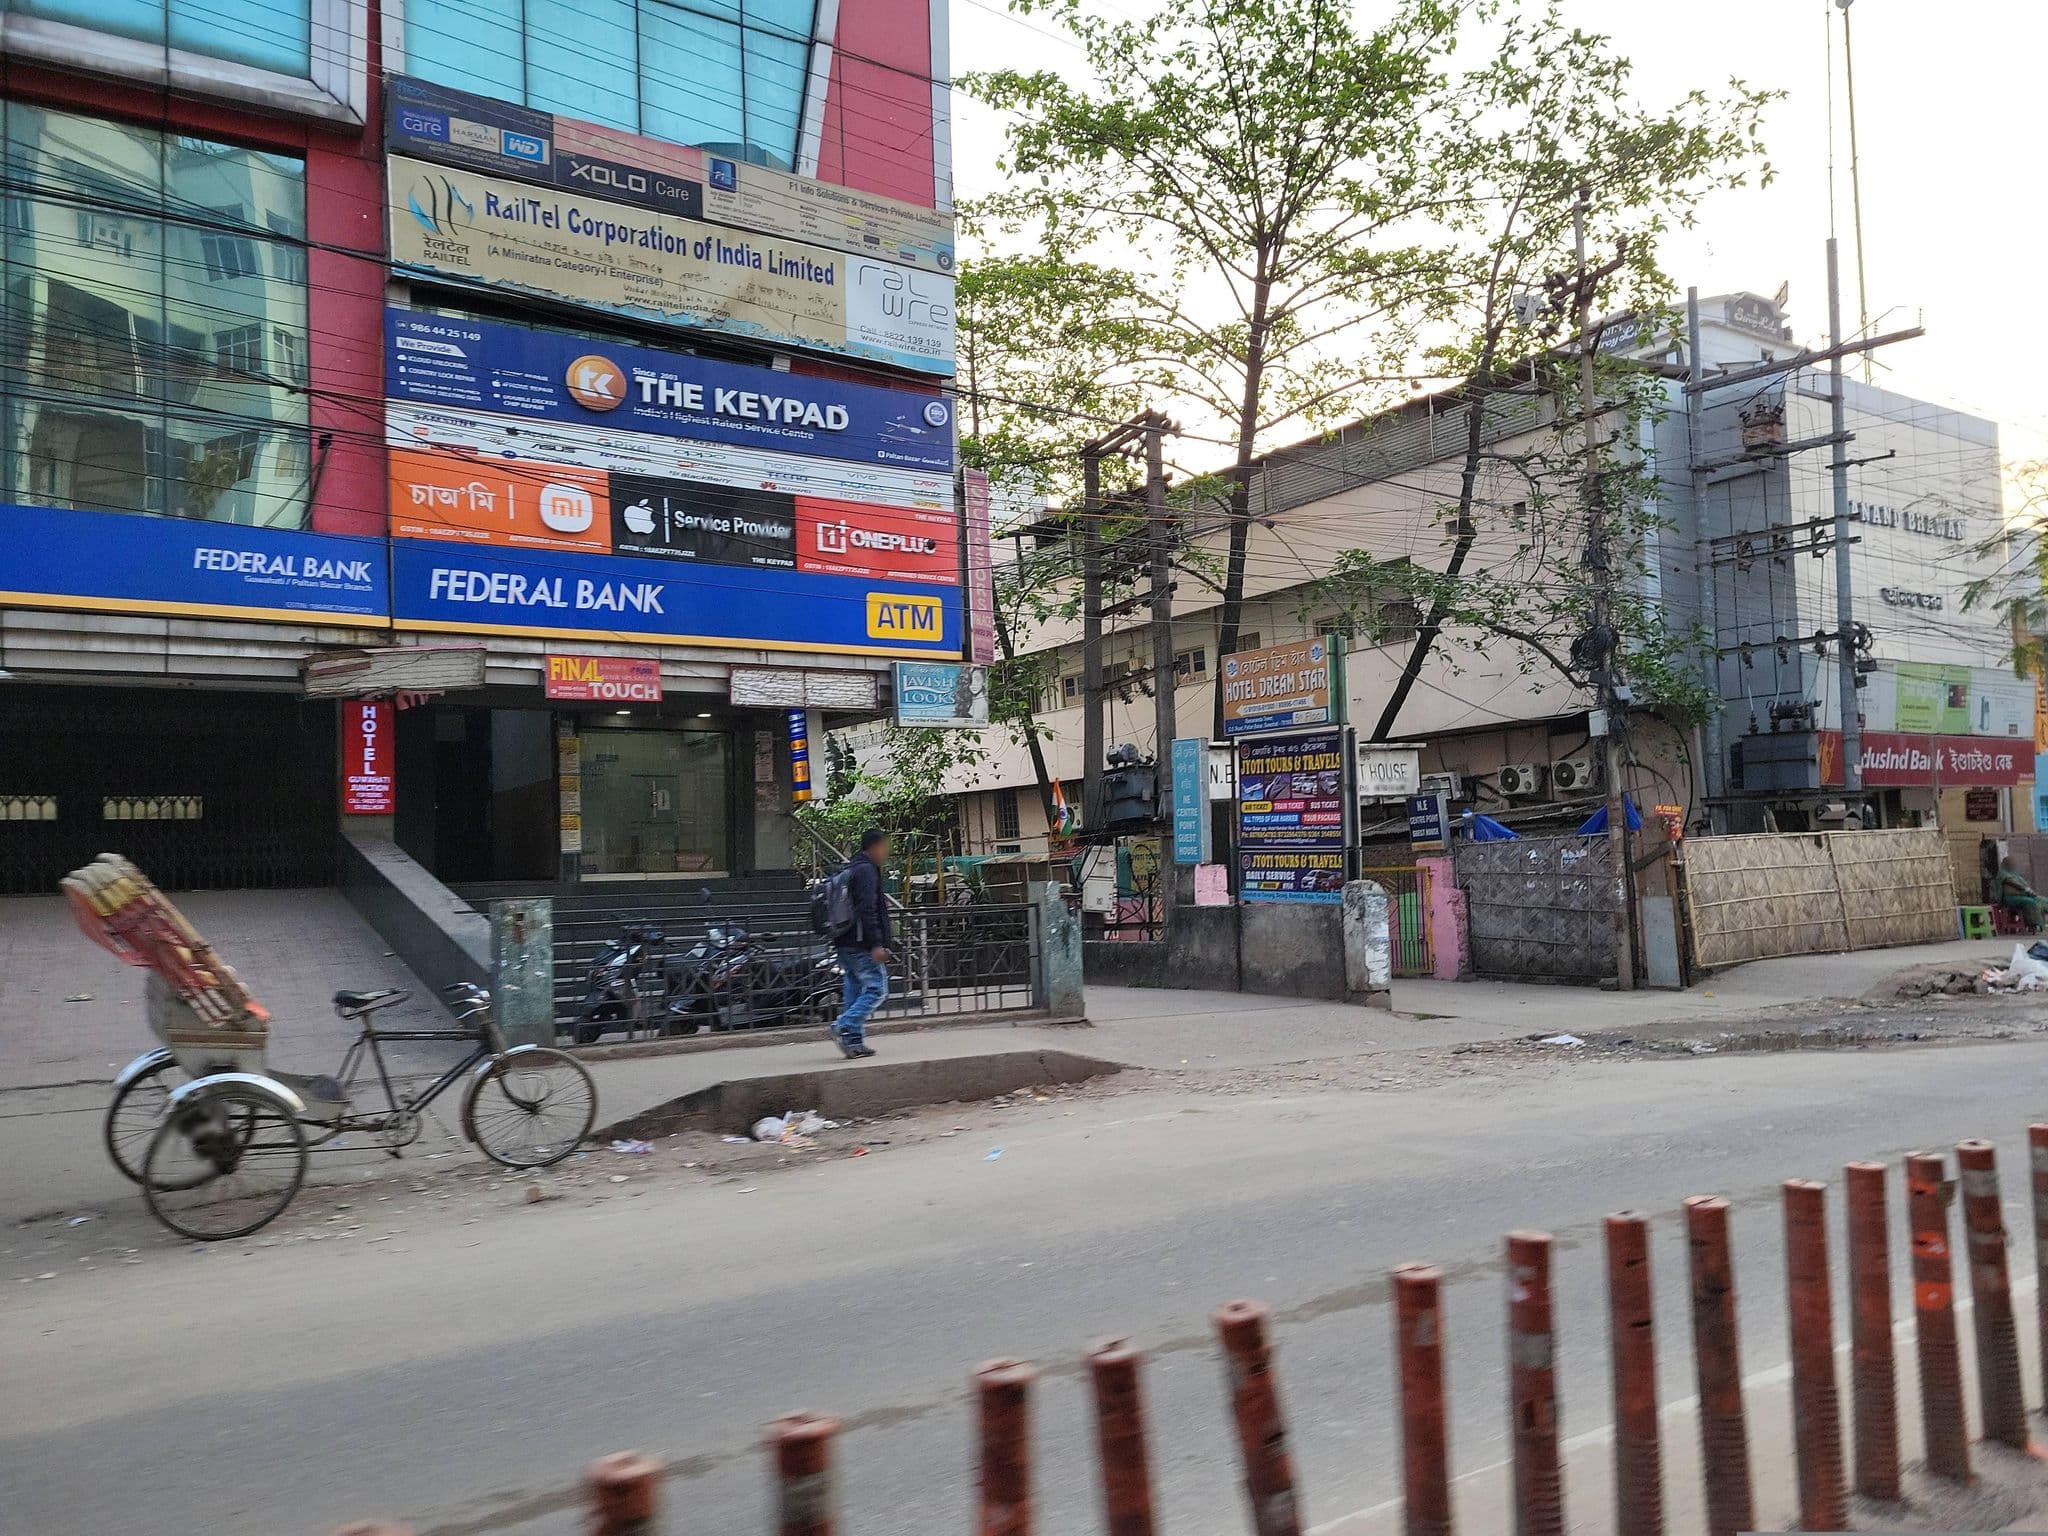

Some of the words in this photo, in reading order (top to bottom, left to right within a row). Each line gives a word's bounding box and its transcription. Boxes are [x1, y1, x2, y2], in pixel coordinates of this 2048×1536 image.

[402, 117, 442, 136] care
[452, 127, 497, 143] HARMAN
[508, 137, 539, 155] WD
[570, 160, 647, 194] XOLO
[655, 180, 689, 200] Care
[485, 191, 561, 230] RailTel
[567, 207, 687, 257] Corporation
[694, 237, 712, 262] of
[716, 241, 762, 270] India
[767, 249, 835, 286] Limited
[422, 249, 472, 267] RAILTEL
[487, 244, 500, 256] (A
[501, 248, 552, 266] Miniratna
[553, 257, 608, 277] Category-I
[609, 267, 664, 288] Enterprise)
[409, 323, 431, 334] 986
[431, 326, 445, 335] 44
[446, 329, 460, 339] 25
[462, 331, 482, 341] 149
[632, 367, 657, 378] Since
[635, 375, 705, 411] THE
[714, 387, 850, 431] KEYPAD
[670, 411, 711, 426] Highest
[711, 417, 744, 431] Rated
[744, 422, 781, 436] Service
[781, 427, 815, 440] Centre
[674, 509, 731, 533] Service
[193, 547, 298, 578] FEDERAL
[303, 557, 372, 583] BANK
[767, 558, 795, 567] KEYPAD
[429, 568, 569, 608] FEDERAL
[575, 579, 665, 615] BANK
[877, 602, 934, 631] ATM
[550, 656, 604, 682] FINAL
[588, 682, 660, 700] TOUCH
[902, 674, 954, 692] LAVISH
[1225, 679, 1257, 705] HOTEL
[1260, 673, 1296, 698] DREAM
[1299, 667, 1329, 692] STAR
[904, 691, 956, 705] LOOKS
[361, 705, 377, 776] HOTEL
[1241, 758, 1265, 775] JYOTI
[1265, 756, 1293, 774] TOURS
[1294, 755, 1301, 768] &
[1302, 752, 1340, 771] TRAVELS
[1370, 763, 1408, 781] HOUSE
[1176, 807, 1199, 817] CENTRE
[1288, 801, 1305, 810] TICKET
[1310, 801, 1321, 810] BUS
[1321, 800, 1339, 809] TICKET
[1179, 820, 1197, 830] POINT
[1178, 846, 1199, 856] HOUSE
[1252, 854, 1274, 869] JYOTI
[1274, 854, 1300, 869] TOURS
[1300, 855, 1308, 868] &
[1308, 854, 1343, 869] TRAVELS
[1245, 871, 1265, 880] DAILY
[1265, 871, 1296, 881] SERVICE
